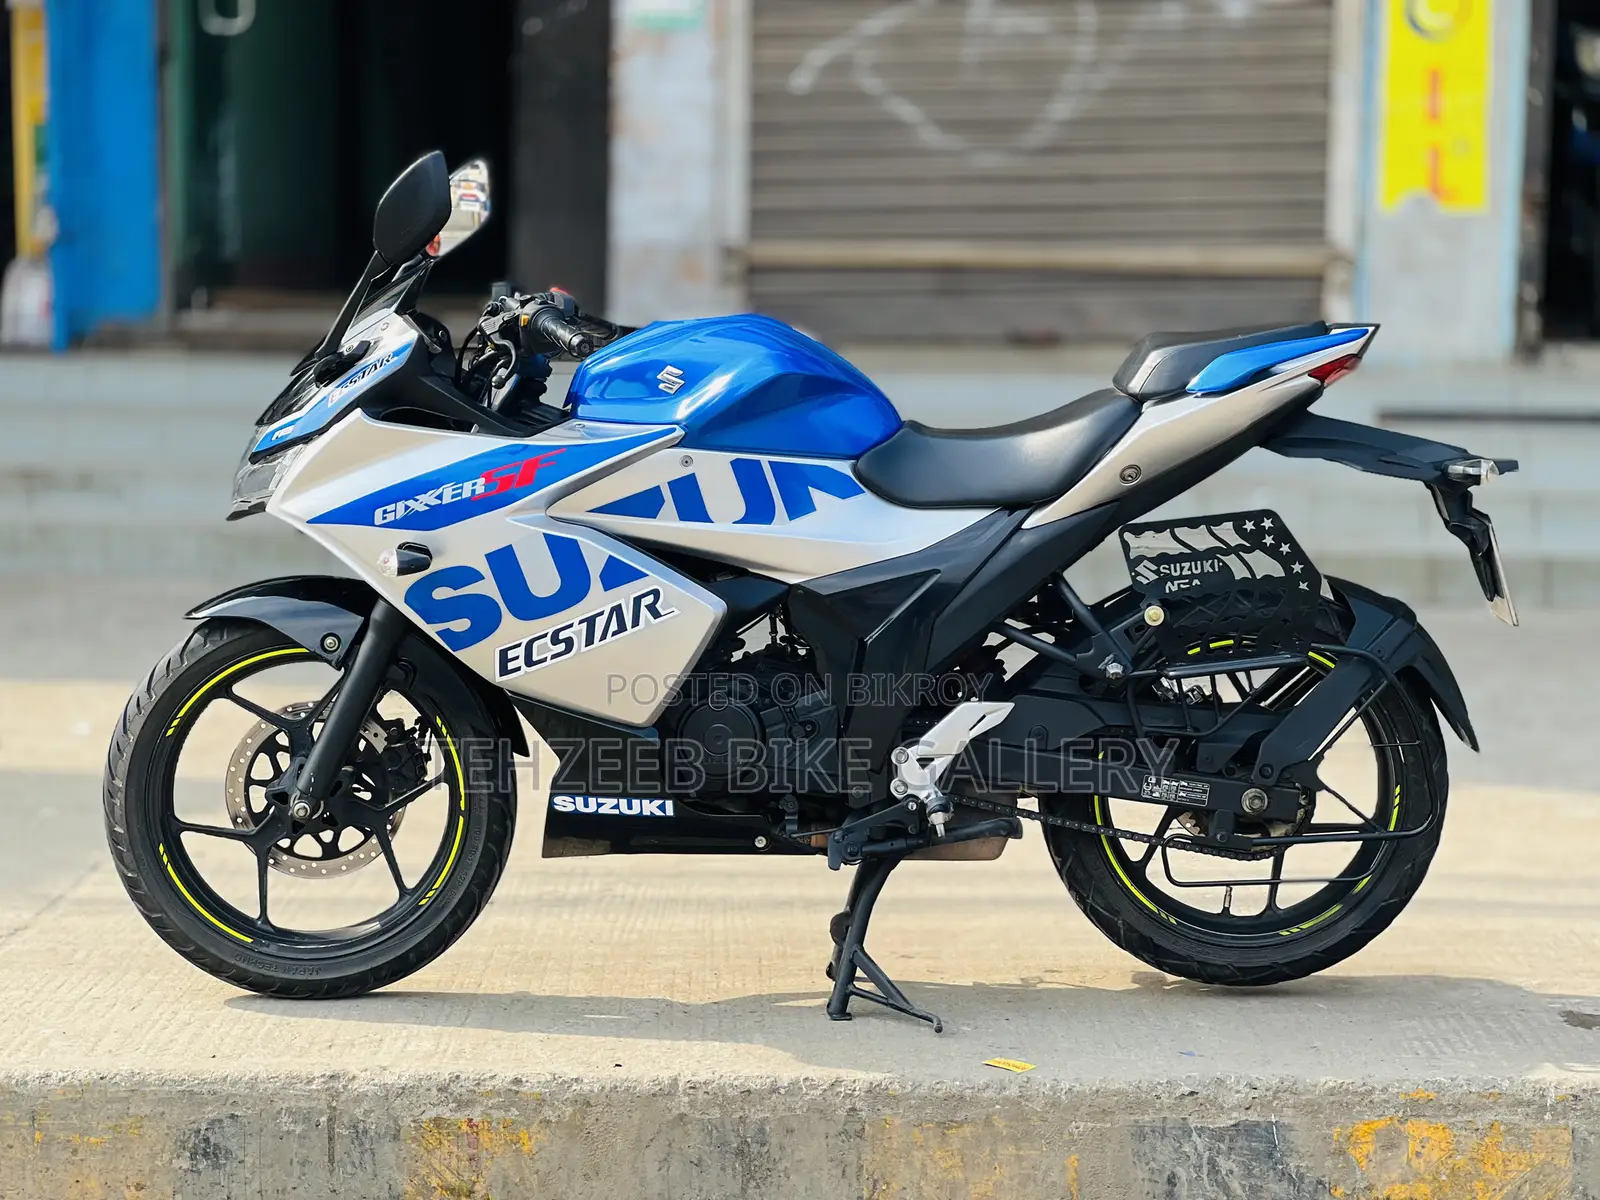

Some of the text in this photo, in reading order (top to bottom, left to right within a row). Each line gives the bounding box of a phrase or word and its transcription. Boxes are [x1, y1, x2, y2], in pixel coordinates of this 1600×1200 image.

[1159, 559, 1219, 577] SUZUKI
[498, 587, 677, 679] ECSTAR
[553, 795, 675, 817] SUZUKI
